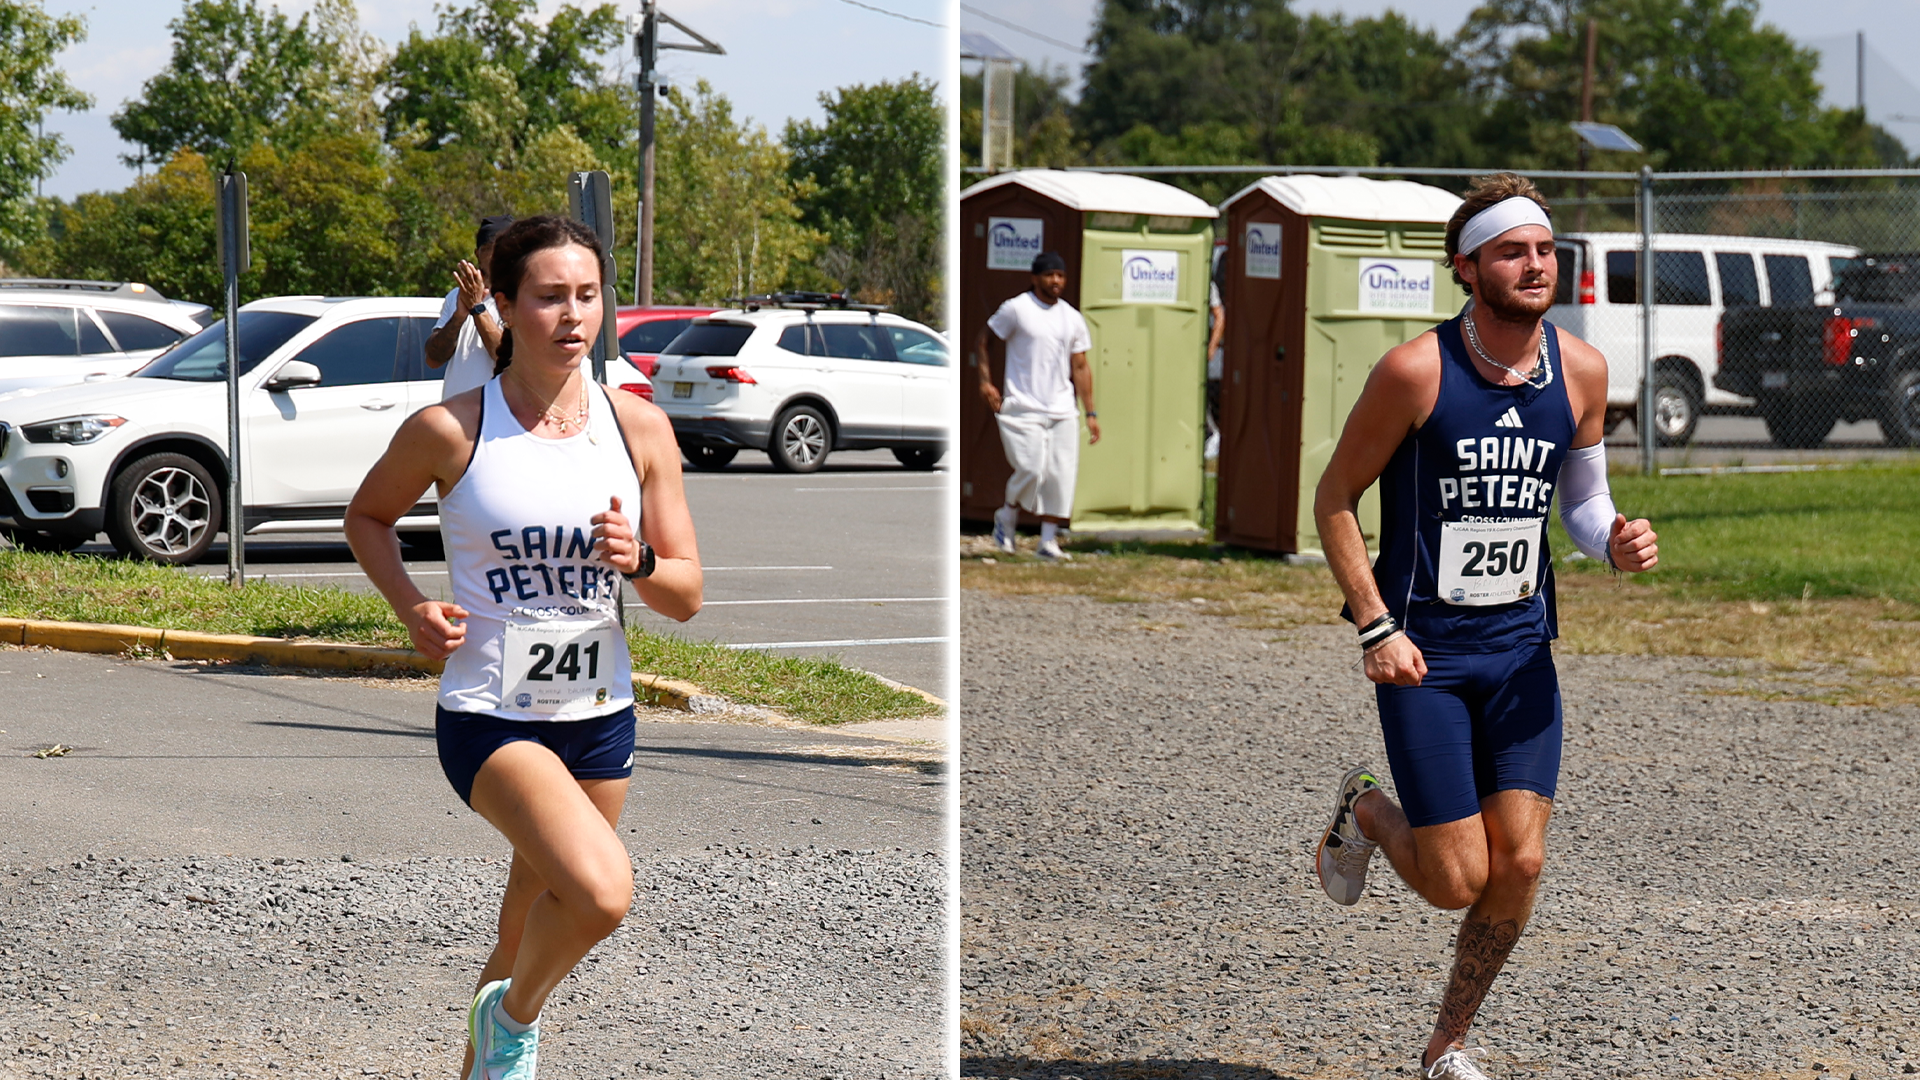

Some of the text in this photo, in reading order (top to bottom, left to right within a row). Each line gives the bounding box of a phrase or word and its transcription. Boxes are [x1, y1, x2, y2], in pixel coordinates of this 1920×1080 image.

[994, 232, 1040, 249] United
[1248, 238, 1279, 256] United
[1130, 265, 1175, 281] United
[1369, 273, 1430, 291] United
[1456, 436, 1556, 473] SAINT
[1438, 475, 1553, 514] PETER'S
[1460, 514, 1495, 524] CROSS
[490, 525, 601, 561] SAIN
[1460, 538, 1529, 577] 250
[485, 563, 615, 604] PETER'S
[521, 605, 559, 618] CROSS
[526, 640, 600, 682] 241
